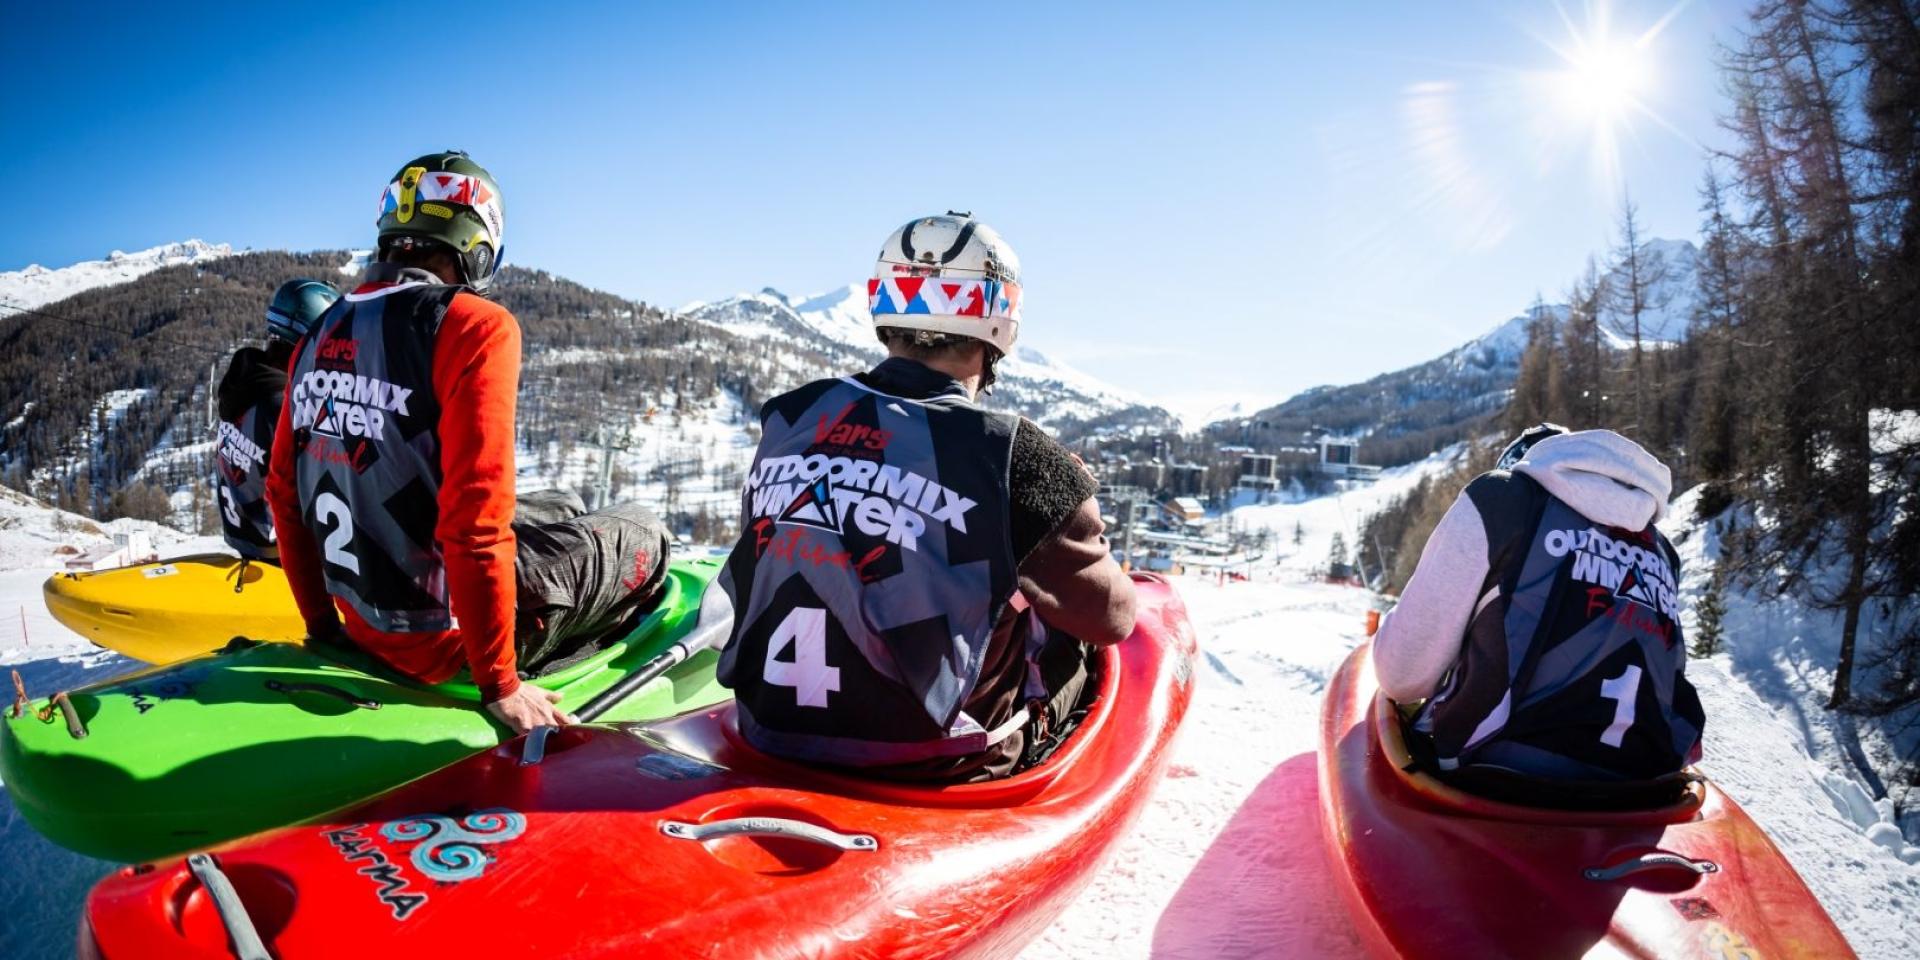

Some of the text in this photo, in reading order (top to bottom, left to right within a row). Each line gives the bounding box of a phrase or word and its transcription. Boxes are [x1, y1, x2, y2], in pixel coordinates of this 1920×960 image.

[815, 402, 893, 450] Vars
[220, 485, 241, 528] 3
[316, 492, 360, 576] 2
[763, 606, 841, 709] 4
[1600, 664, 1643, 749] 1
